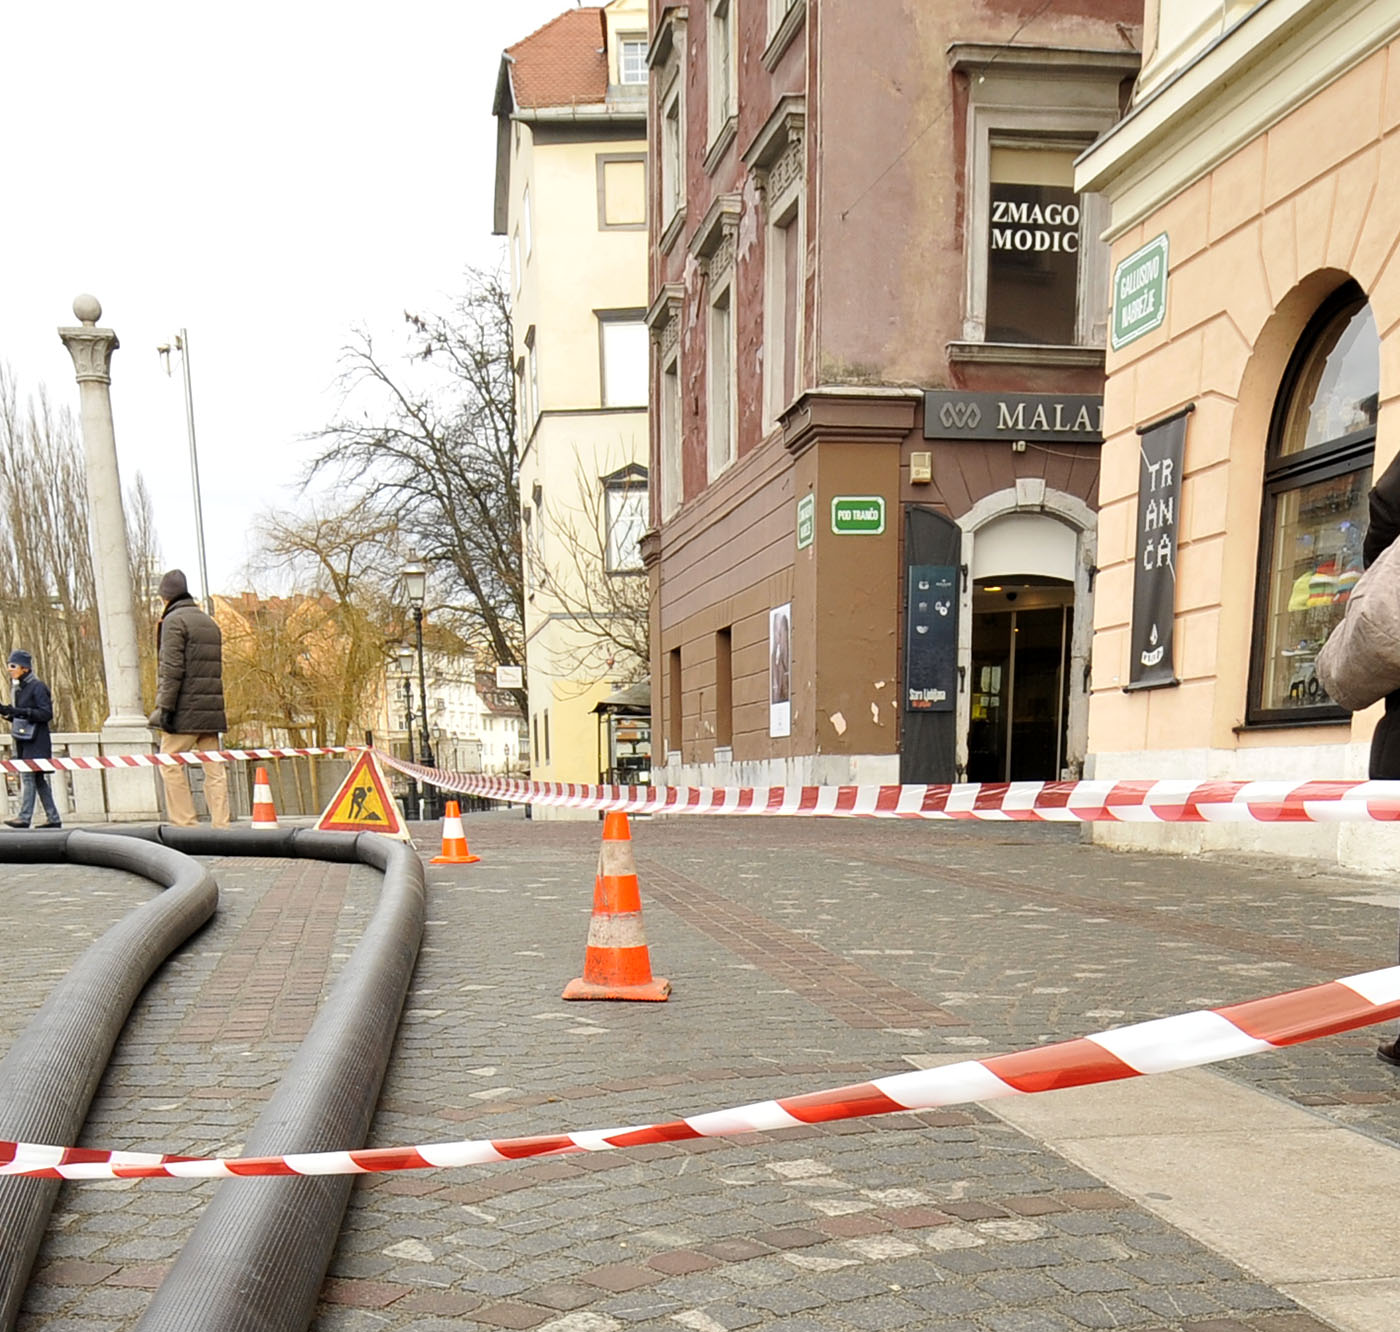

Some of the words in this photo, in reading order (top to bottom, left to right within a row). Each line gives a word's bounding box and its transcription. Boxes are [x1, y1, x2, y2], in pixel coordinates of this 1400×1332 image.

[991, 201, 1080, 226] ZMAGO
[991, 229, 1079, 253] MODIC
[1120, 255, 1160, 300] GALLUSOVO
[1121, 288, 1156, 329] NABREŽJE
